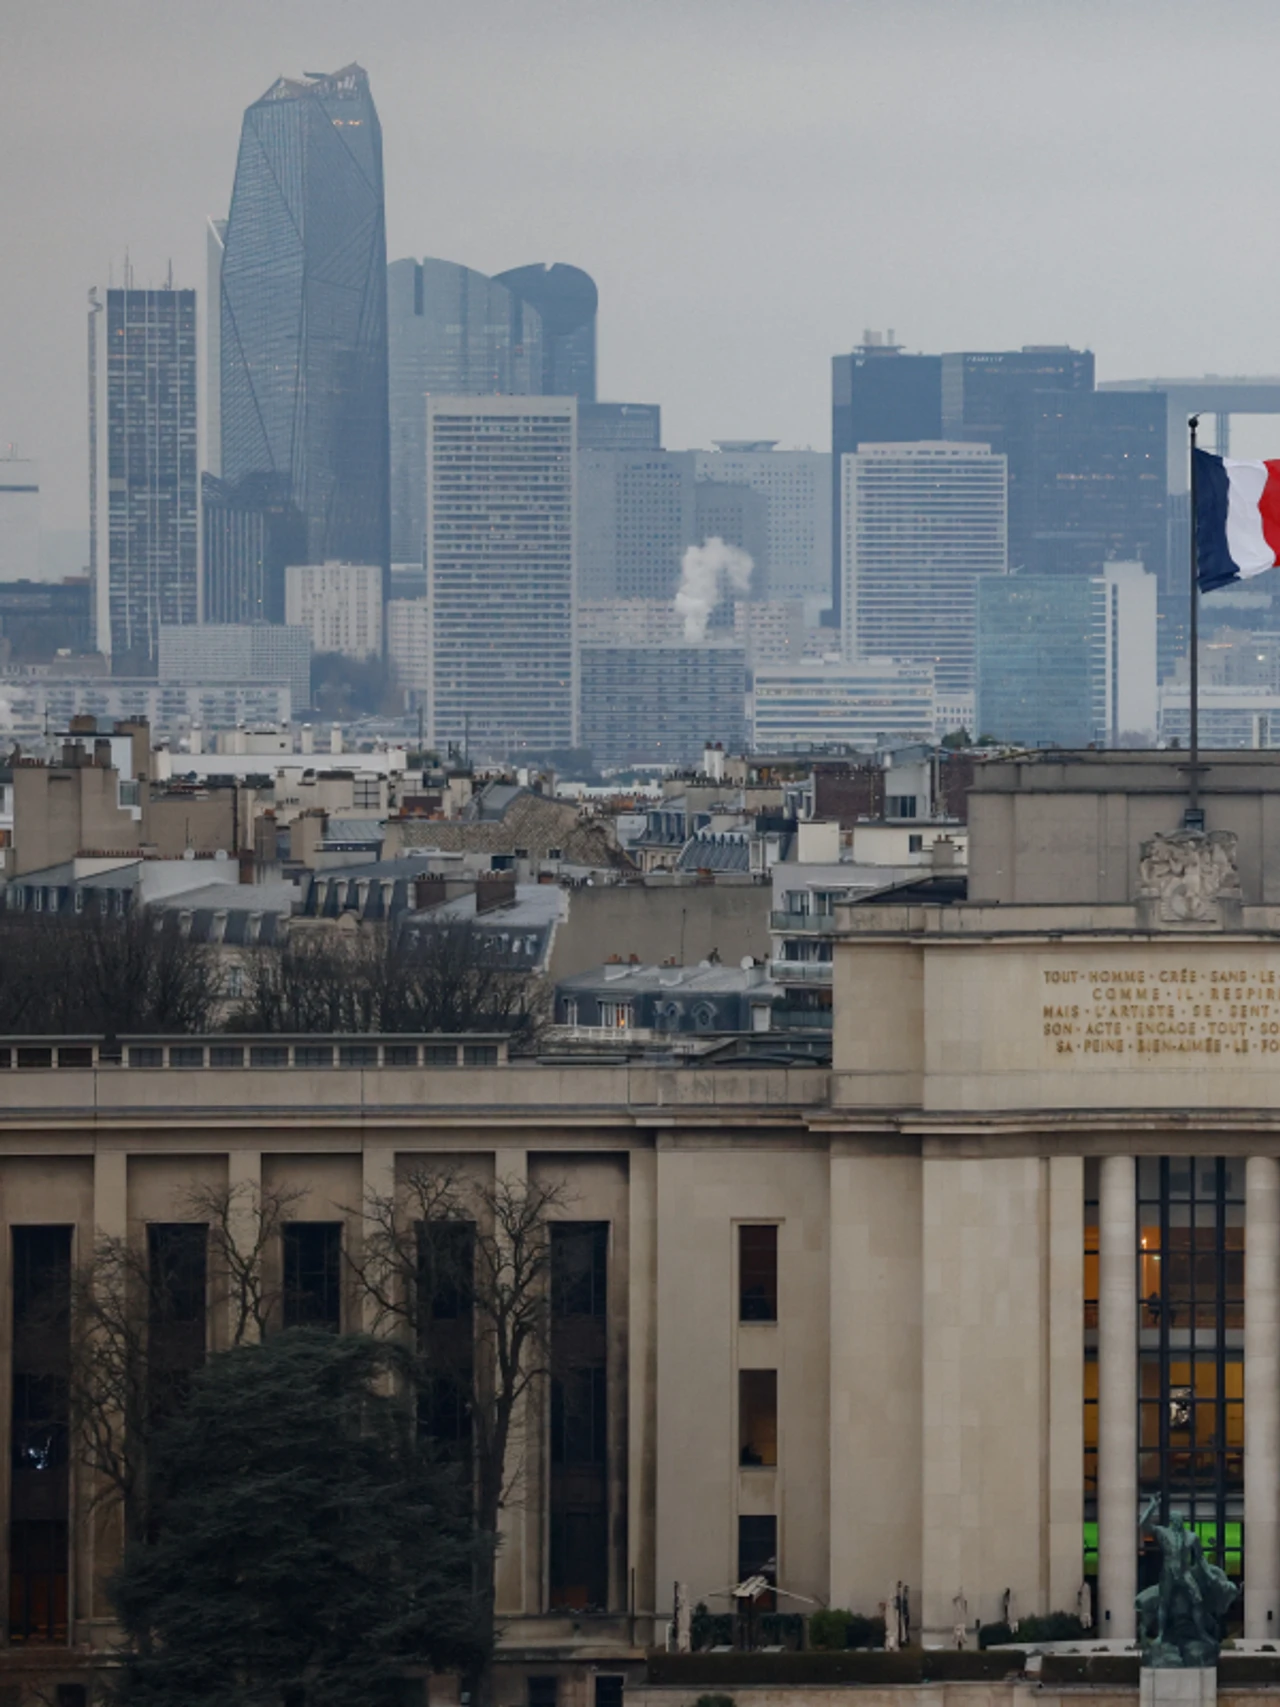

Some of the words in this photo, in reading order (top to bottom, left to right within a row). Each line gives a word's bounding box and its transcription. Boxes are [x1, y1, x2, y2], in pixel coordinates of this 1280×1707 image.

[1043, 970, 1078, 984] TOUT
[1089, 970, 1145, 984] HOMME
[1159, 968, 1197, 984] CRÉE
[1210, 970, 1248, 984] SANS
[1259, 970, 1275, 984] LE
[1092, 987, 1160, 1001] COMME
[1177, 987, 1194, 1001] IL
[1043, 1004, 1079, 1019] MAIS
[1095, 1004, 1175, 1019] L'ARTISTE
[1193, 1004, 1212, 1018] SE
[1230, 1004, 1270, 1018] SENT
[1043, 1021, 1073, 1036] SON
[1085, 1021, 1122, 1036] ACTE
[1136, 1021, 1196, 1036] ENGAGE
[1208, 1021, 1248, 1036] TOUT
[1056, 1038, 1073, 1053] SA
[1084, 1038, 1124, 1053] PEINE
[1137, 1037, 1222, 1053] BIEN-AIMÉE
[1233, 1038, 1249, 1053] LE
